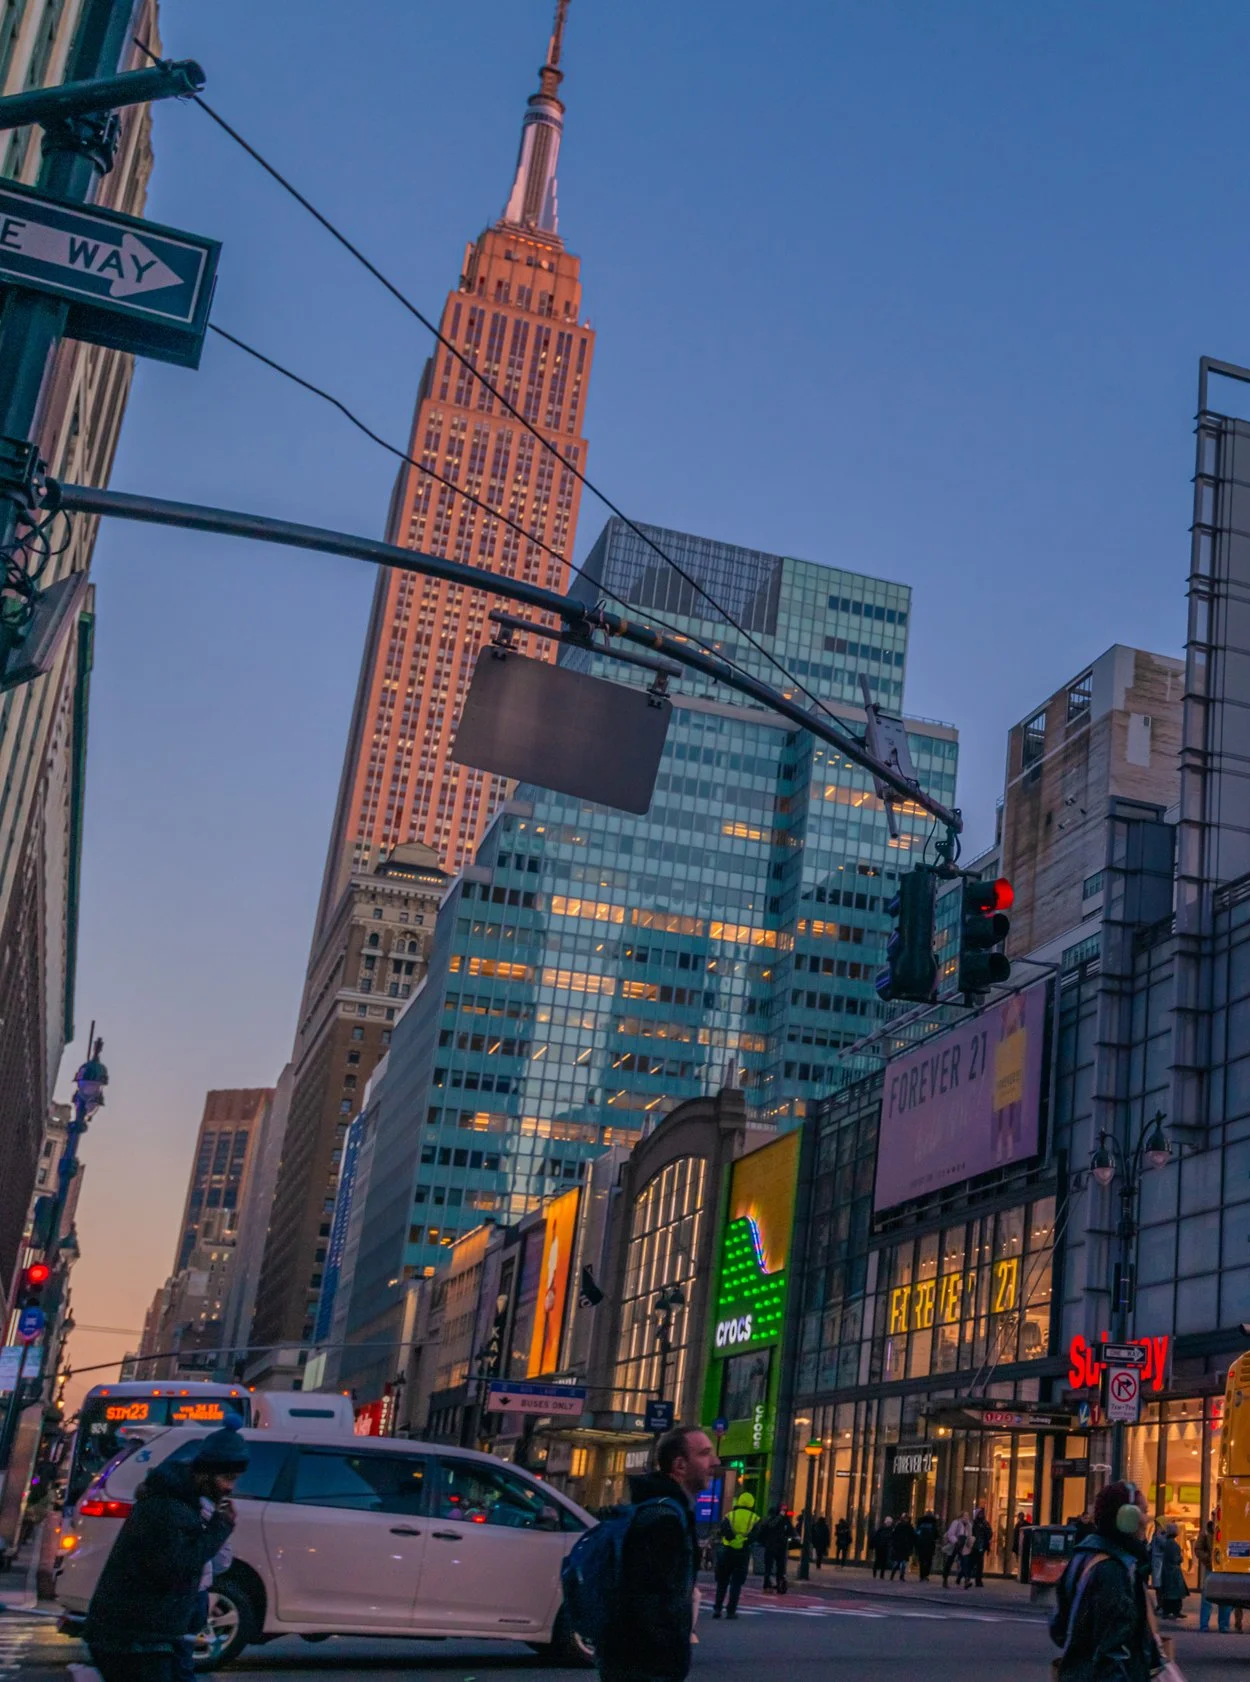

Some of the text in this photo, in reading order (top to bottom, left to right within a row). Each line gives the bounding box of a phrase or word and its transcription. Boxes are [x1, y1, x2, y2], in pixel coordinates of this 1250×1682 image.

[68, 236, 157, 284] WAY
[888, 1030, 989, 1119] FOREVER 21
[991, 1257, 1019, 1313] 21
[488, 1327, 500, 1368] KAY
[716, 1314, 752, 1347] crocs
[106, 1403, 149, 1421] SIM23
[521, 1399, 575, 1410] BUSES ONLY
[753, 1405, 765, 1449] crocs
